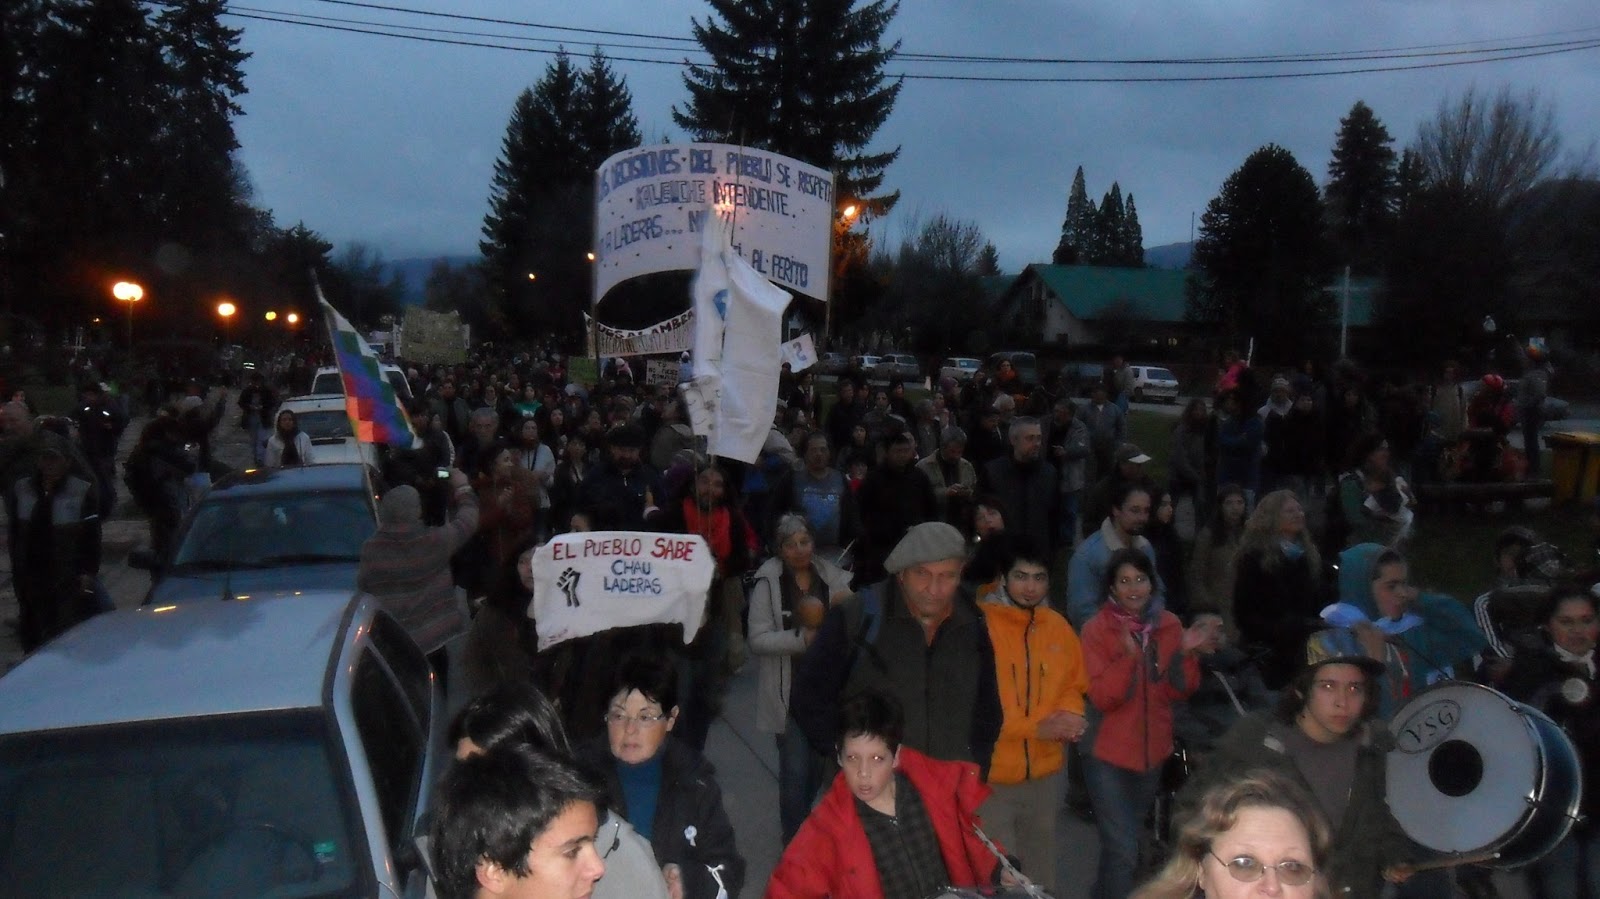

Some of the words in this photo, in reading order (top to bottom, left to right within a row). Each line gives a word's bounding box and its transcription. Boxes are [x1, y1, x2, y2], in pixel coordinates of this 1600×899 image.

[690, 149, 717, 174] DEL
[726, 152, 772, 184] PUEBLO
[776, 163, 791, 188] SE
[752, 248, 767, 274] AL
[553, 542, 577, 561] EL
[584, 538, 642, 558] PUEBLO
[650, 537, 698, 562] SABE
[610, 559, 652, 577] CHAU
[603, 576, 663, 595] LADERAS
